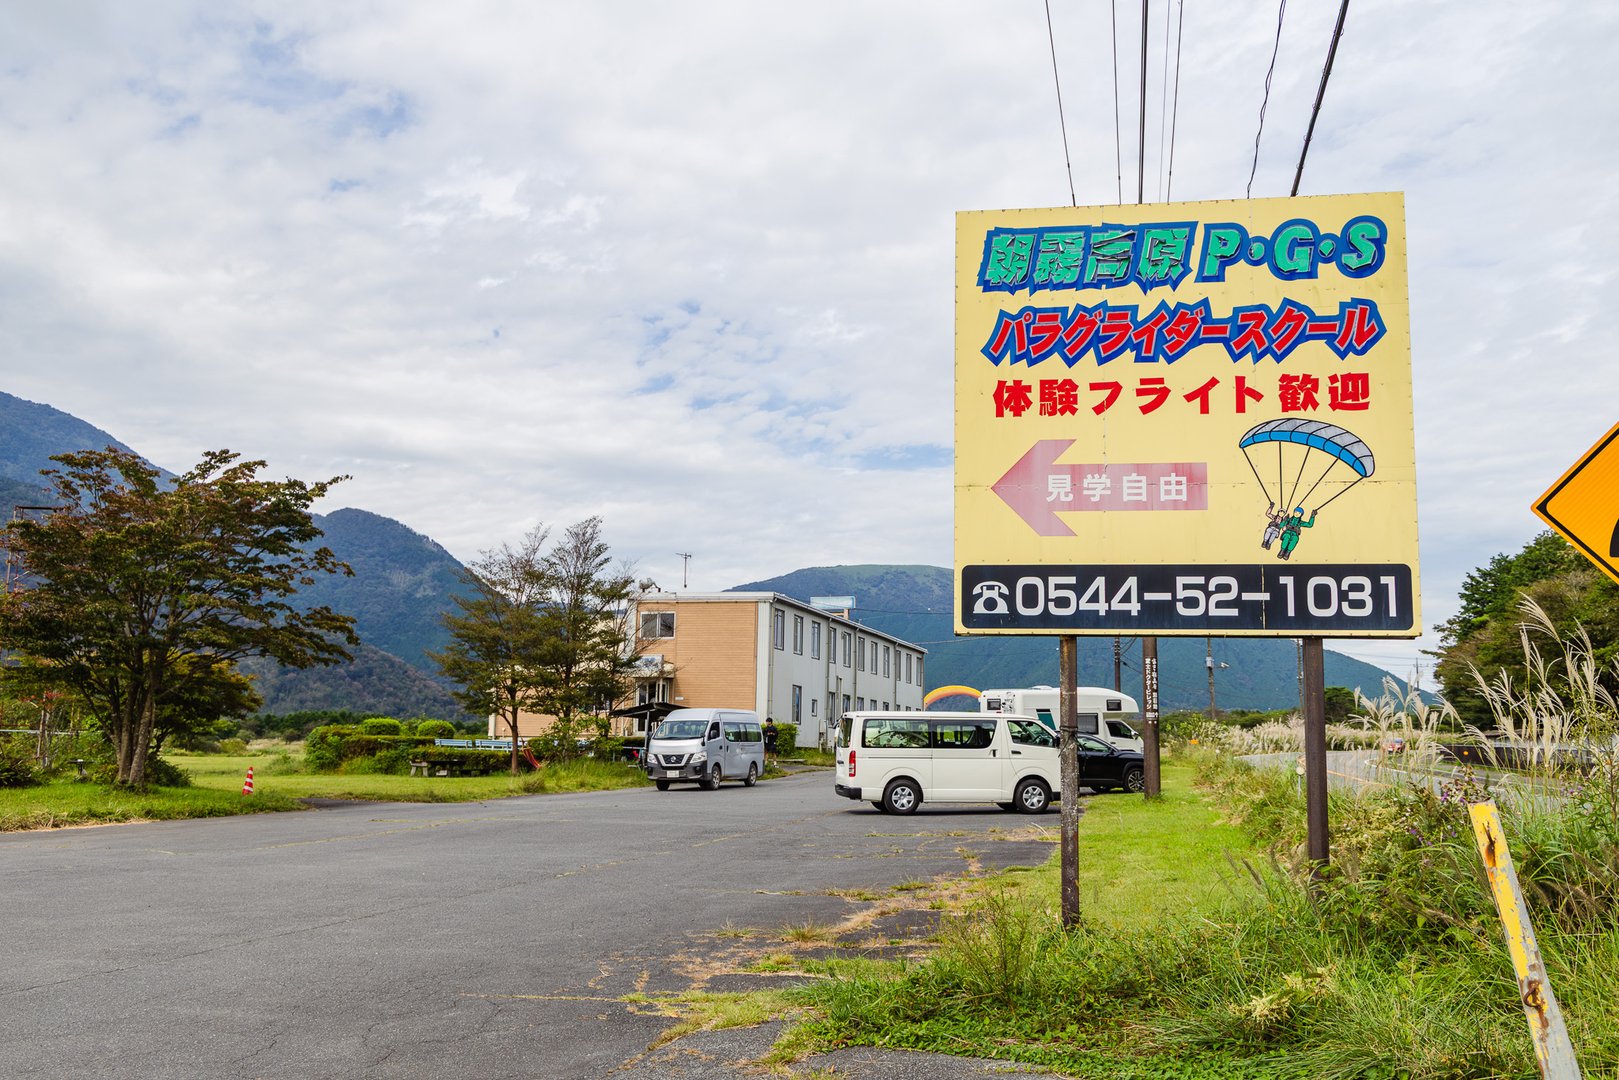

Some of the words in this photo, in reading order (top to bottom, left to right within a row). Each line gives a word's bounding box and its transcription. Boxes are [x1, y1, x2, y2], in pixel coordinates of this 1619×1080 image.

[981, 226, 1191, 290] 朝霧高原
[988, 302, 1379, 361] パラグライダースクール
[992, 372, 1371, 418] 体験フライト歓迎
[1045, 472, 1189, 503] 見学自由
[1014, 575, 1398, 618] 0544-52-1031
